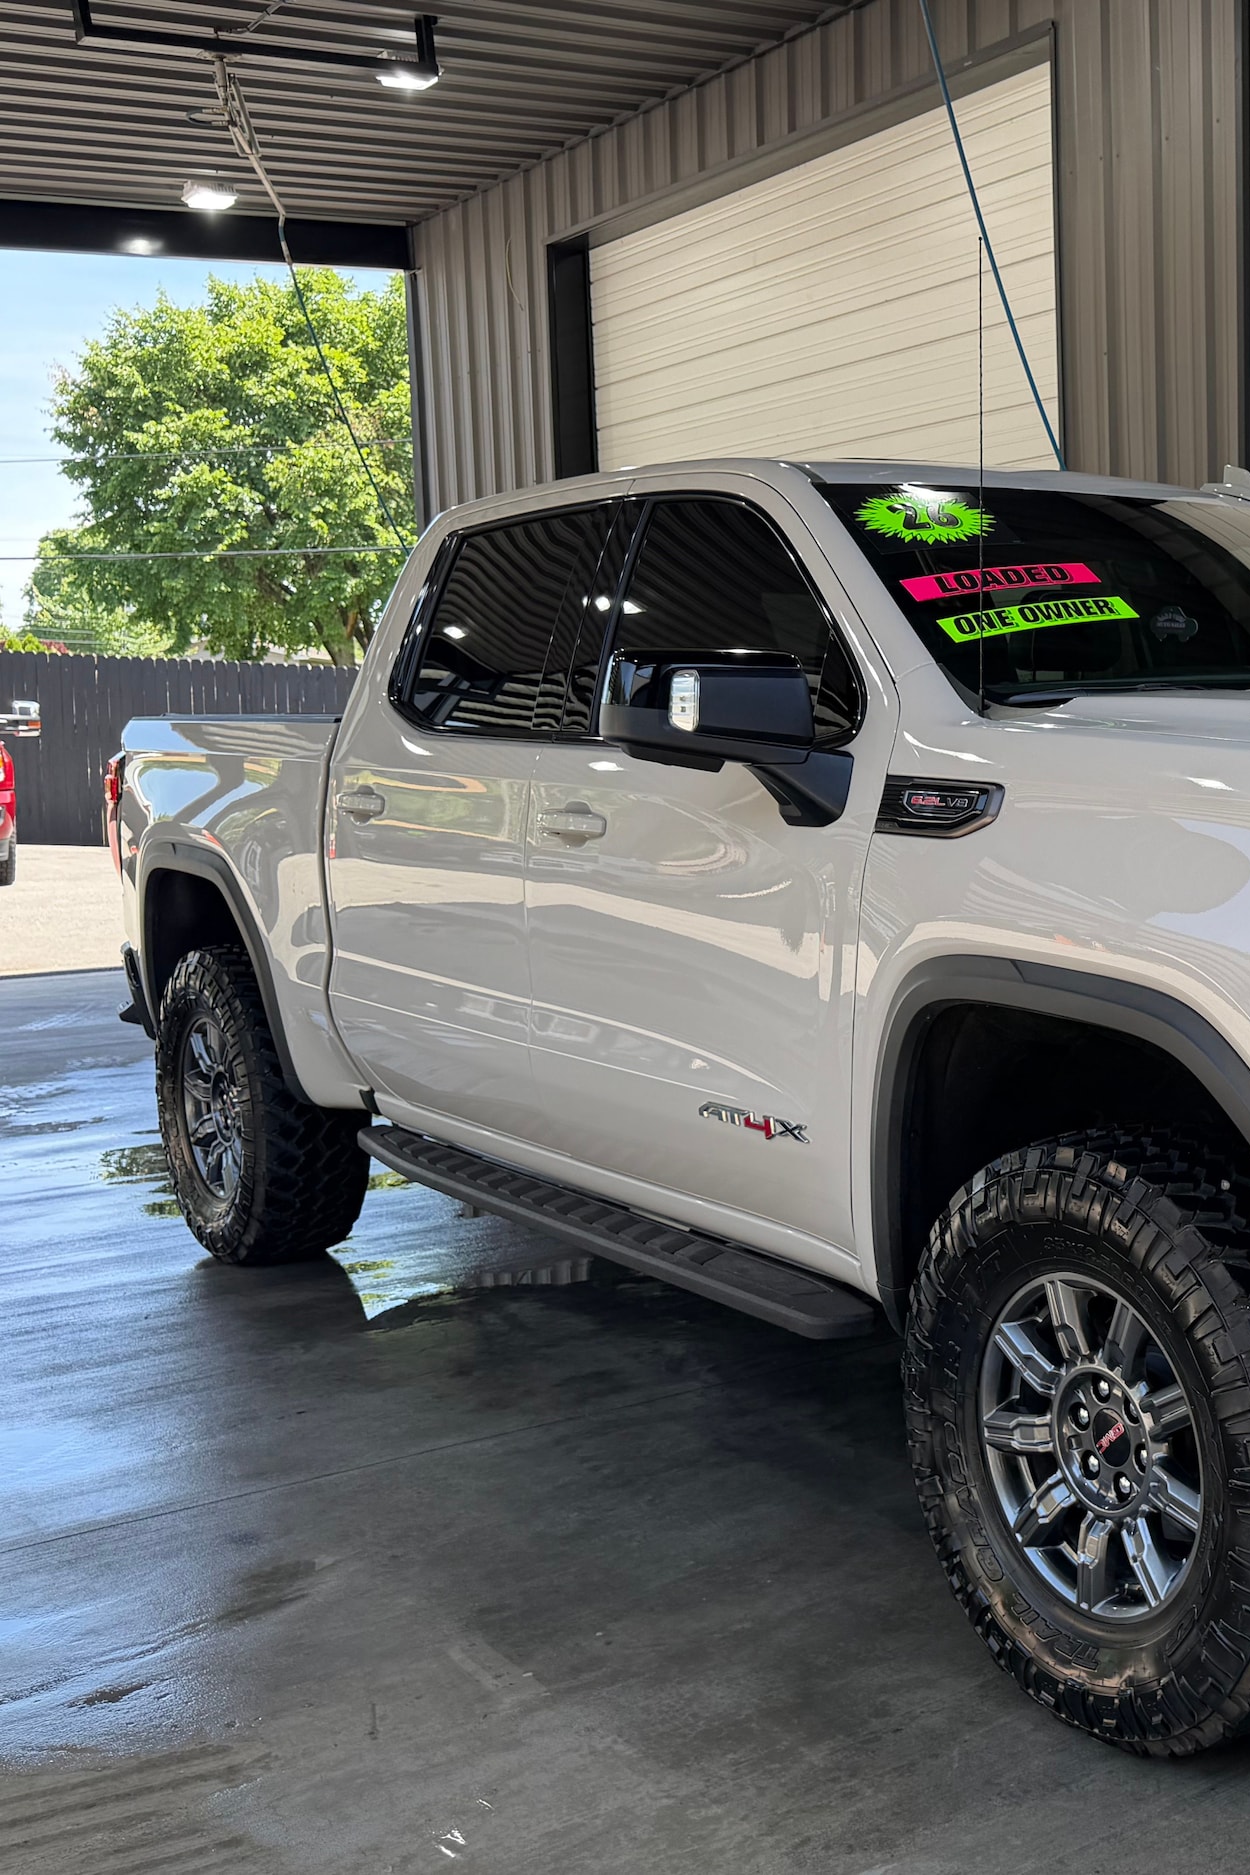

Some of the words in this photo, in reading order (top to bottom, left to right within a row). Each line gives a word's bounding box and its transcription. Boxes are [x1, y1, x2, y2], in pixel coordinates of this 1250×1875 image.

[886, 500, 961, 531] 26
[934, 563, 1074, 596] LOADED
[953, 609, 1018, 638] ONE
[1026, 597, 1119, 625] OWNER
[699, 1101, 811, 1144] AT4X
[1096, 1422, 1125, 1455] GMC
